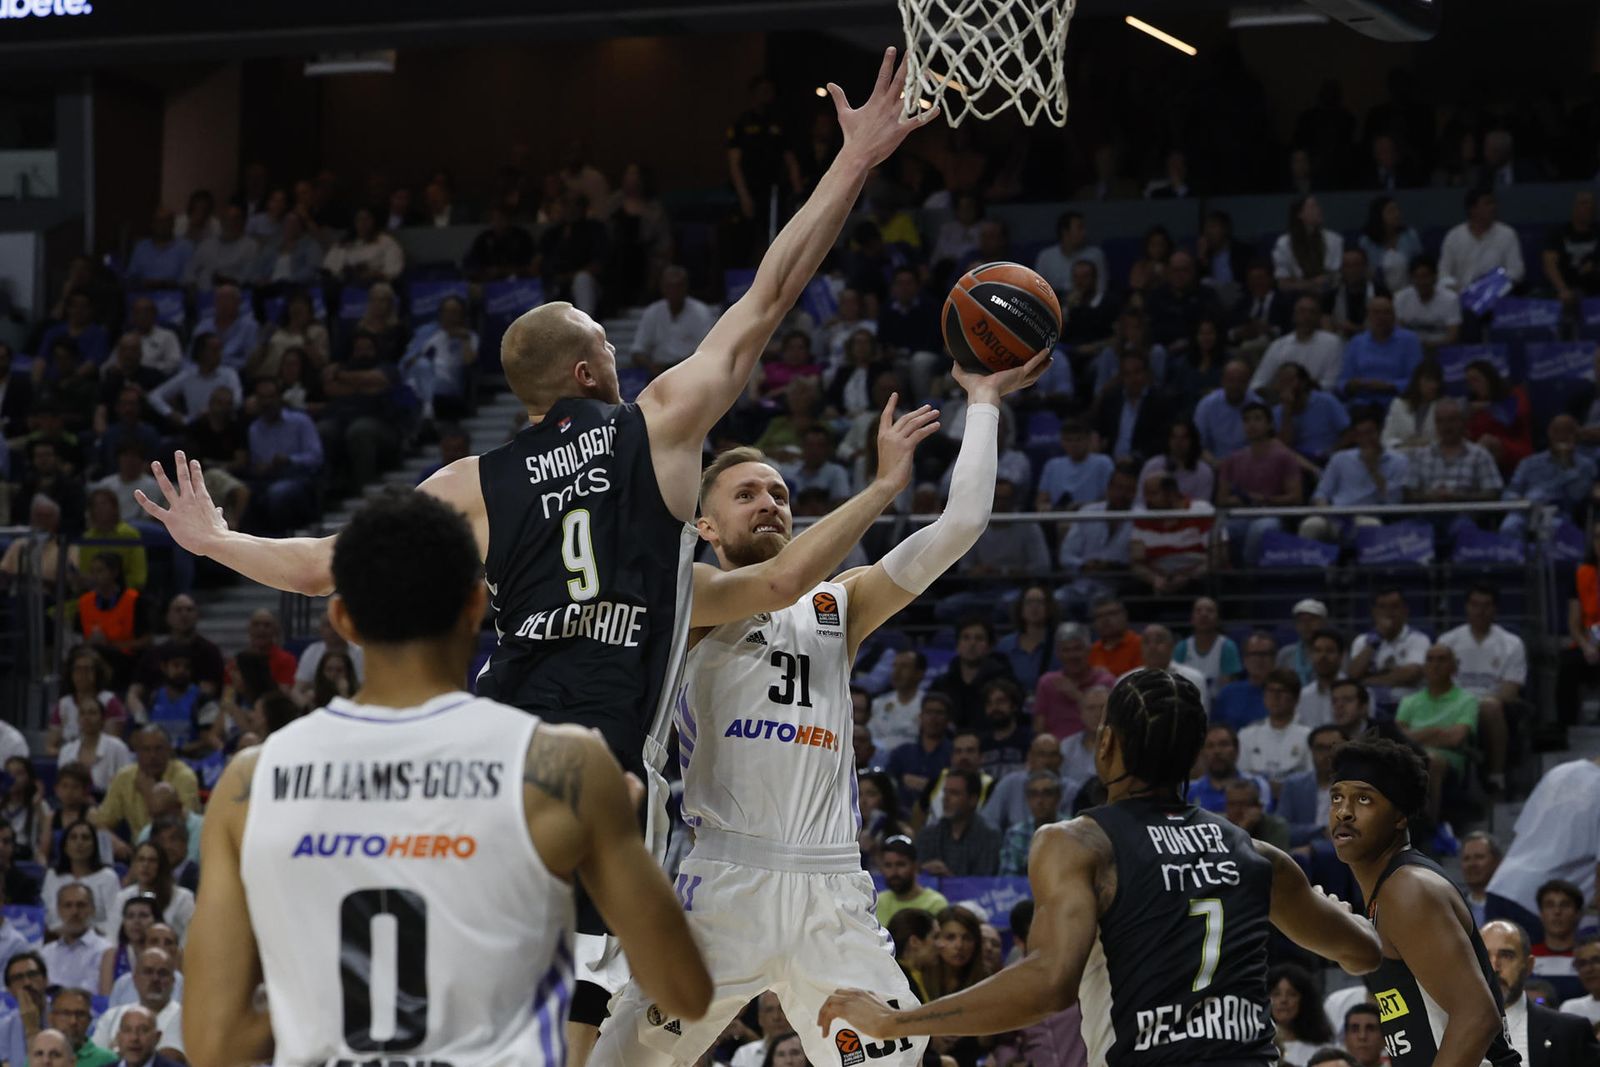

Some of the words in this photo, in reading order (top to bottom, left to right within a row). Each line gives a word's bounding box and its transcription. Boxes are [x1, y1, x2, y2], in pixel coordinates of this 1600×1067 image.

[990, 295, 1024, 318] AIRLINES
[541, 467, 611, 519] mts
[561, 508, 600, 602] 9
[515, 603, 647, 647] BELGRADE
[768, 650, 813, 708] 31
[273, 761, 504, 801] WILLIAMS-GOSS
[292, 833, 477, 859] AUTOHERO
[1146, 823, 1230, 855] PUNTER
[1161, 857, 1241, 892] mts
[1187, 898, 1224, 992] 7
[339, 887, 428, 1053] 0
[1134, 995, 1266, 1051] BELGRADE
